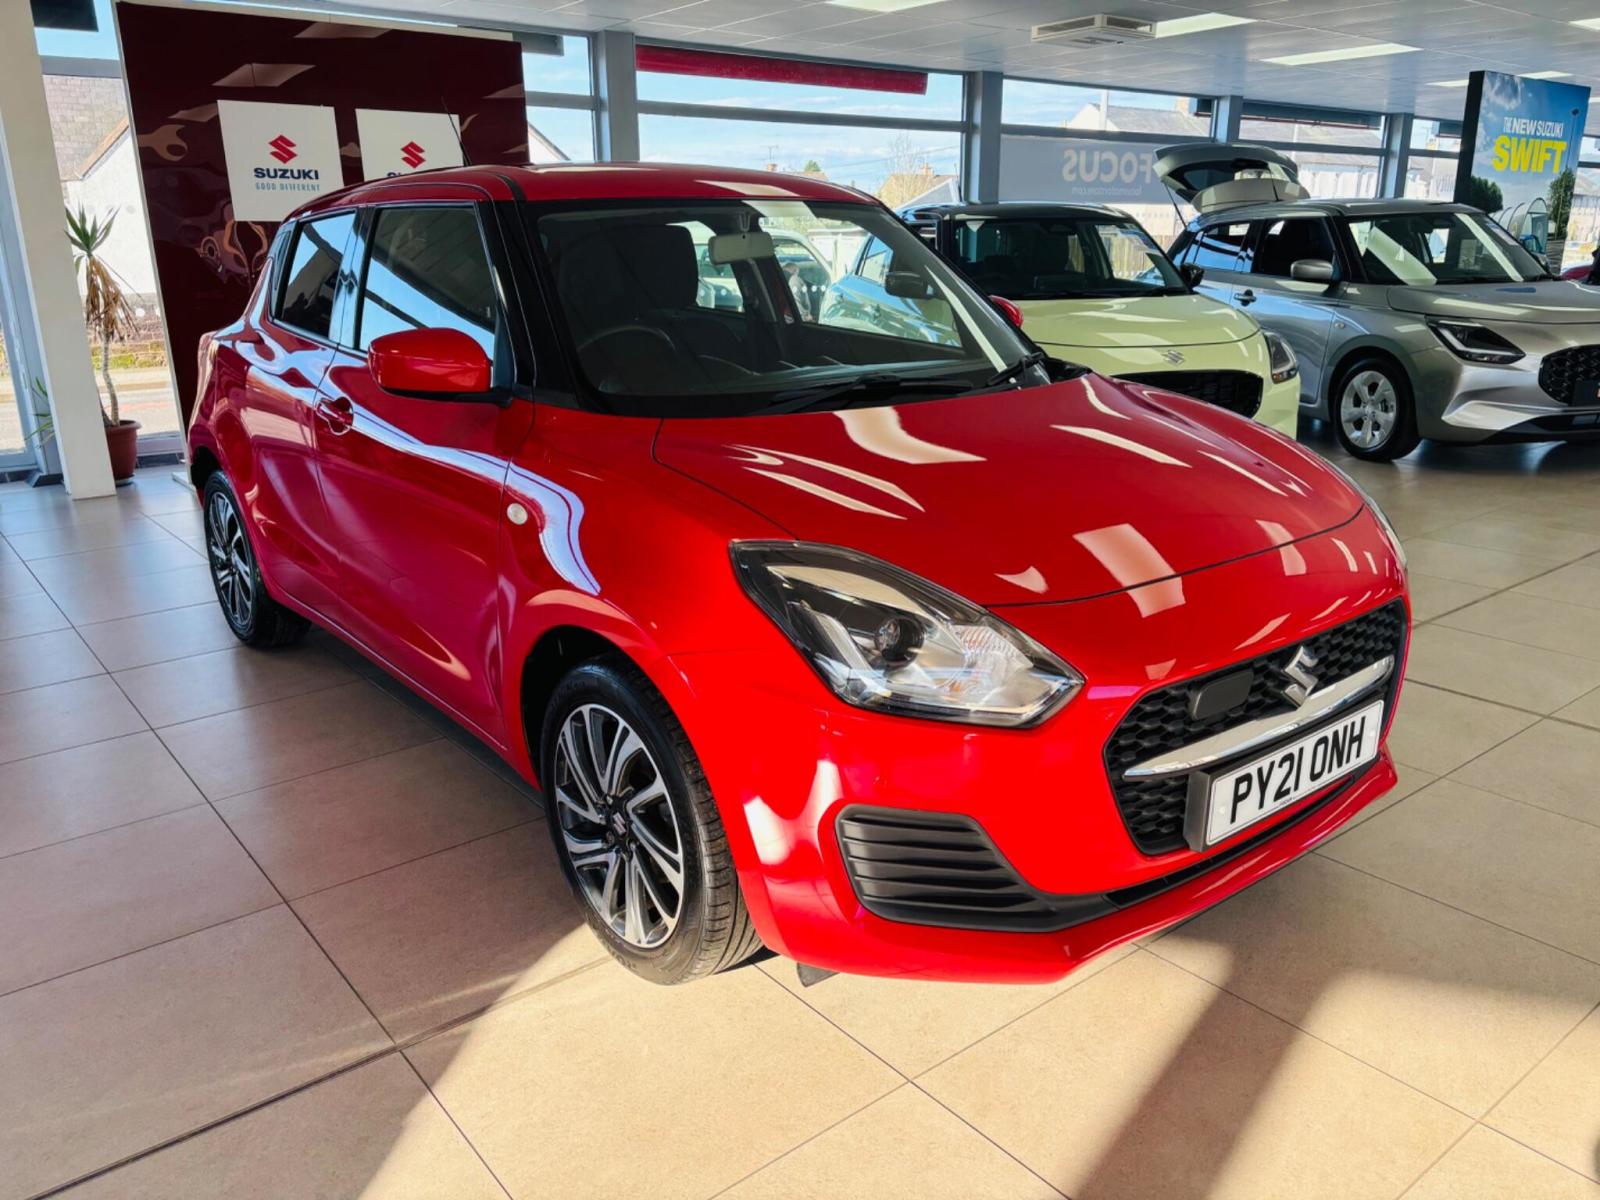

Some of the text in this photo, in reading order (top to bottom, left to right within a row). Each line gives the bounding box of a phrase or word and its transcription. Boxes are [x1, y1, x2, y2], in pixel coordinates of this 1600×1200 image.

[1511, 117, 1537, 135] NEW
[1536, 121, 1564, 138] SUZUKI
[1492, 134, 1567, 174] SWIFT
[253, 167, 319, 180] SUZUKI
[255, 182, 277, 191] GOOD
[1229, 715, 1367, 825] PY21 ONH
